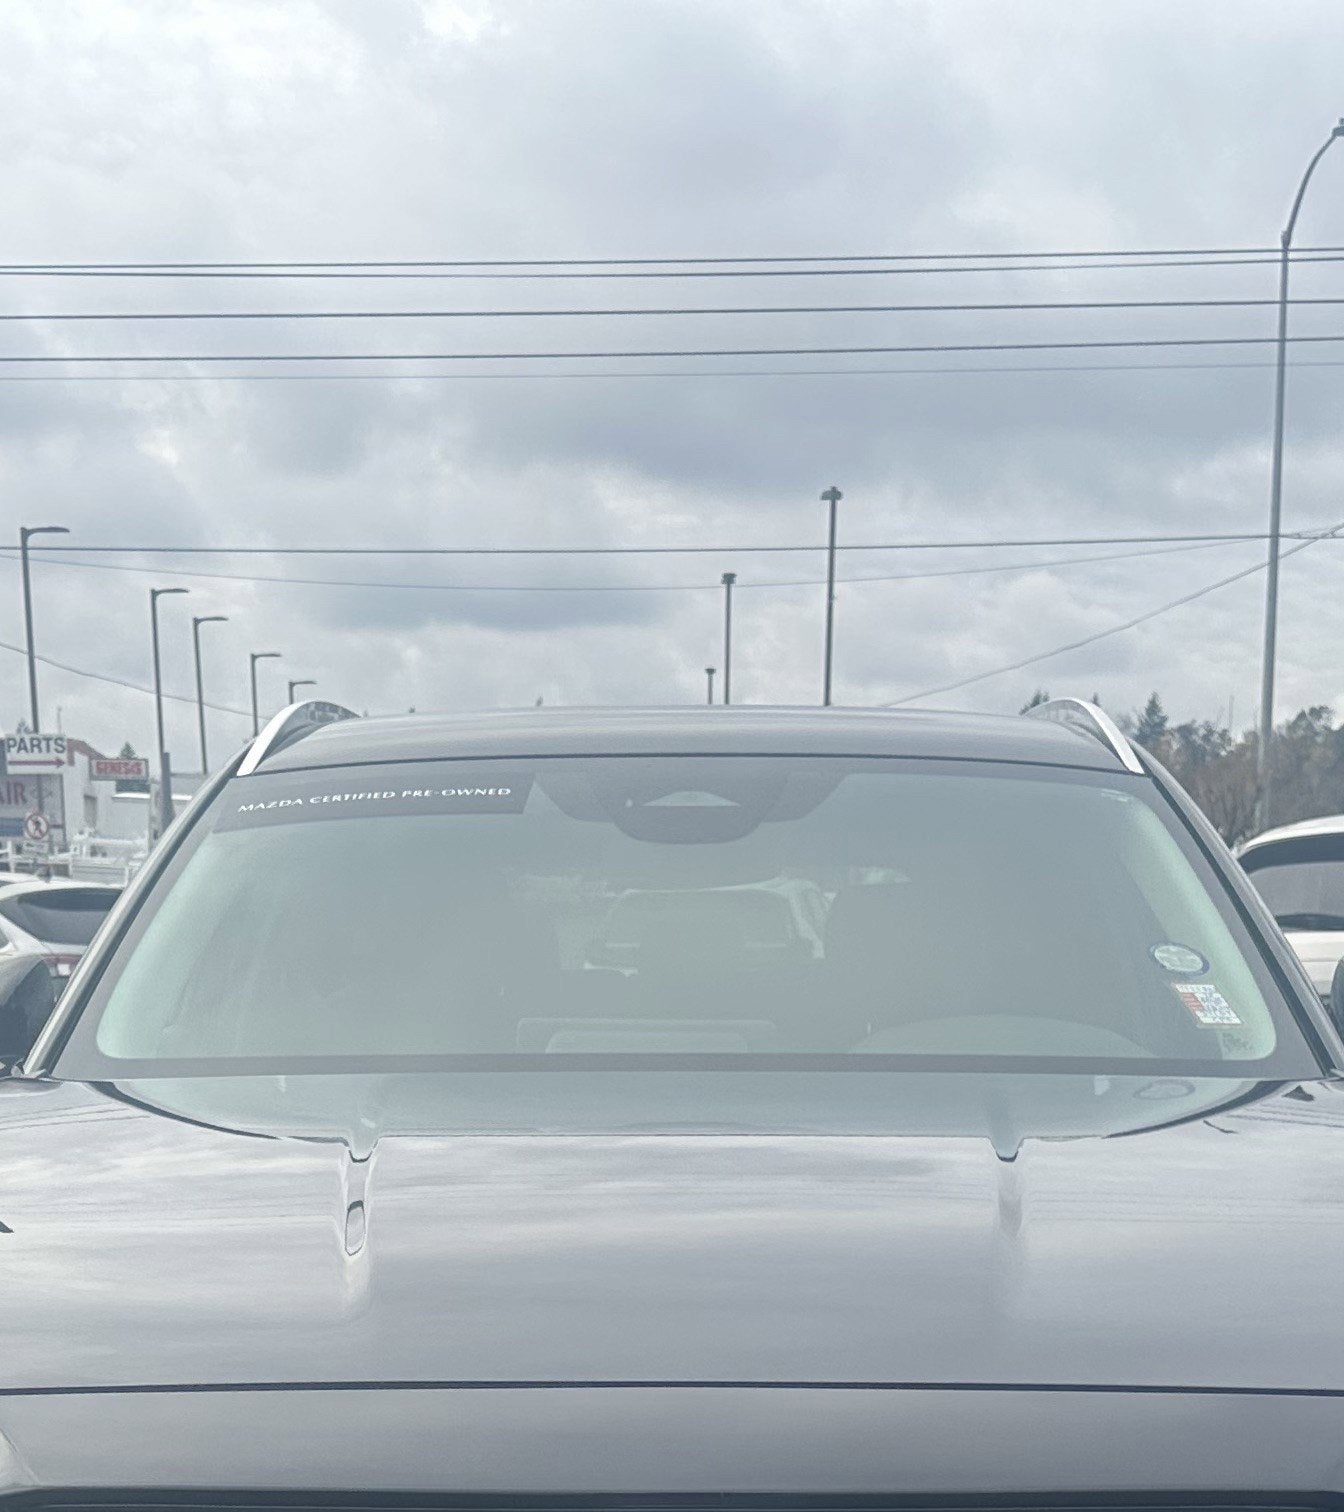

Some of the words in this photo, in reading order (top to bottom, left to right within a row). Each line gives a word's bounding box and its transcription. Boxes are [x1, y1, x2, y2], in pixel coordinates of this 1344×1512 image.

[6, 737, 66, 754] PARTS
[238, 798, 303, 812] MAZDA
[309, 791, 396, 804] CERTIFIED
[402, 788, 511, 798] PRE-OWNED
